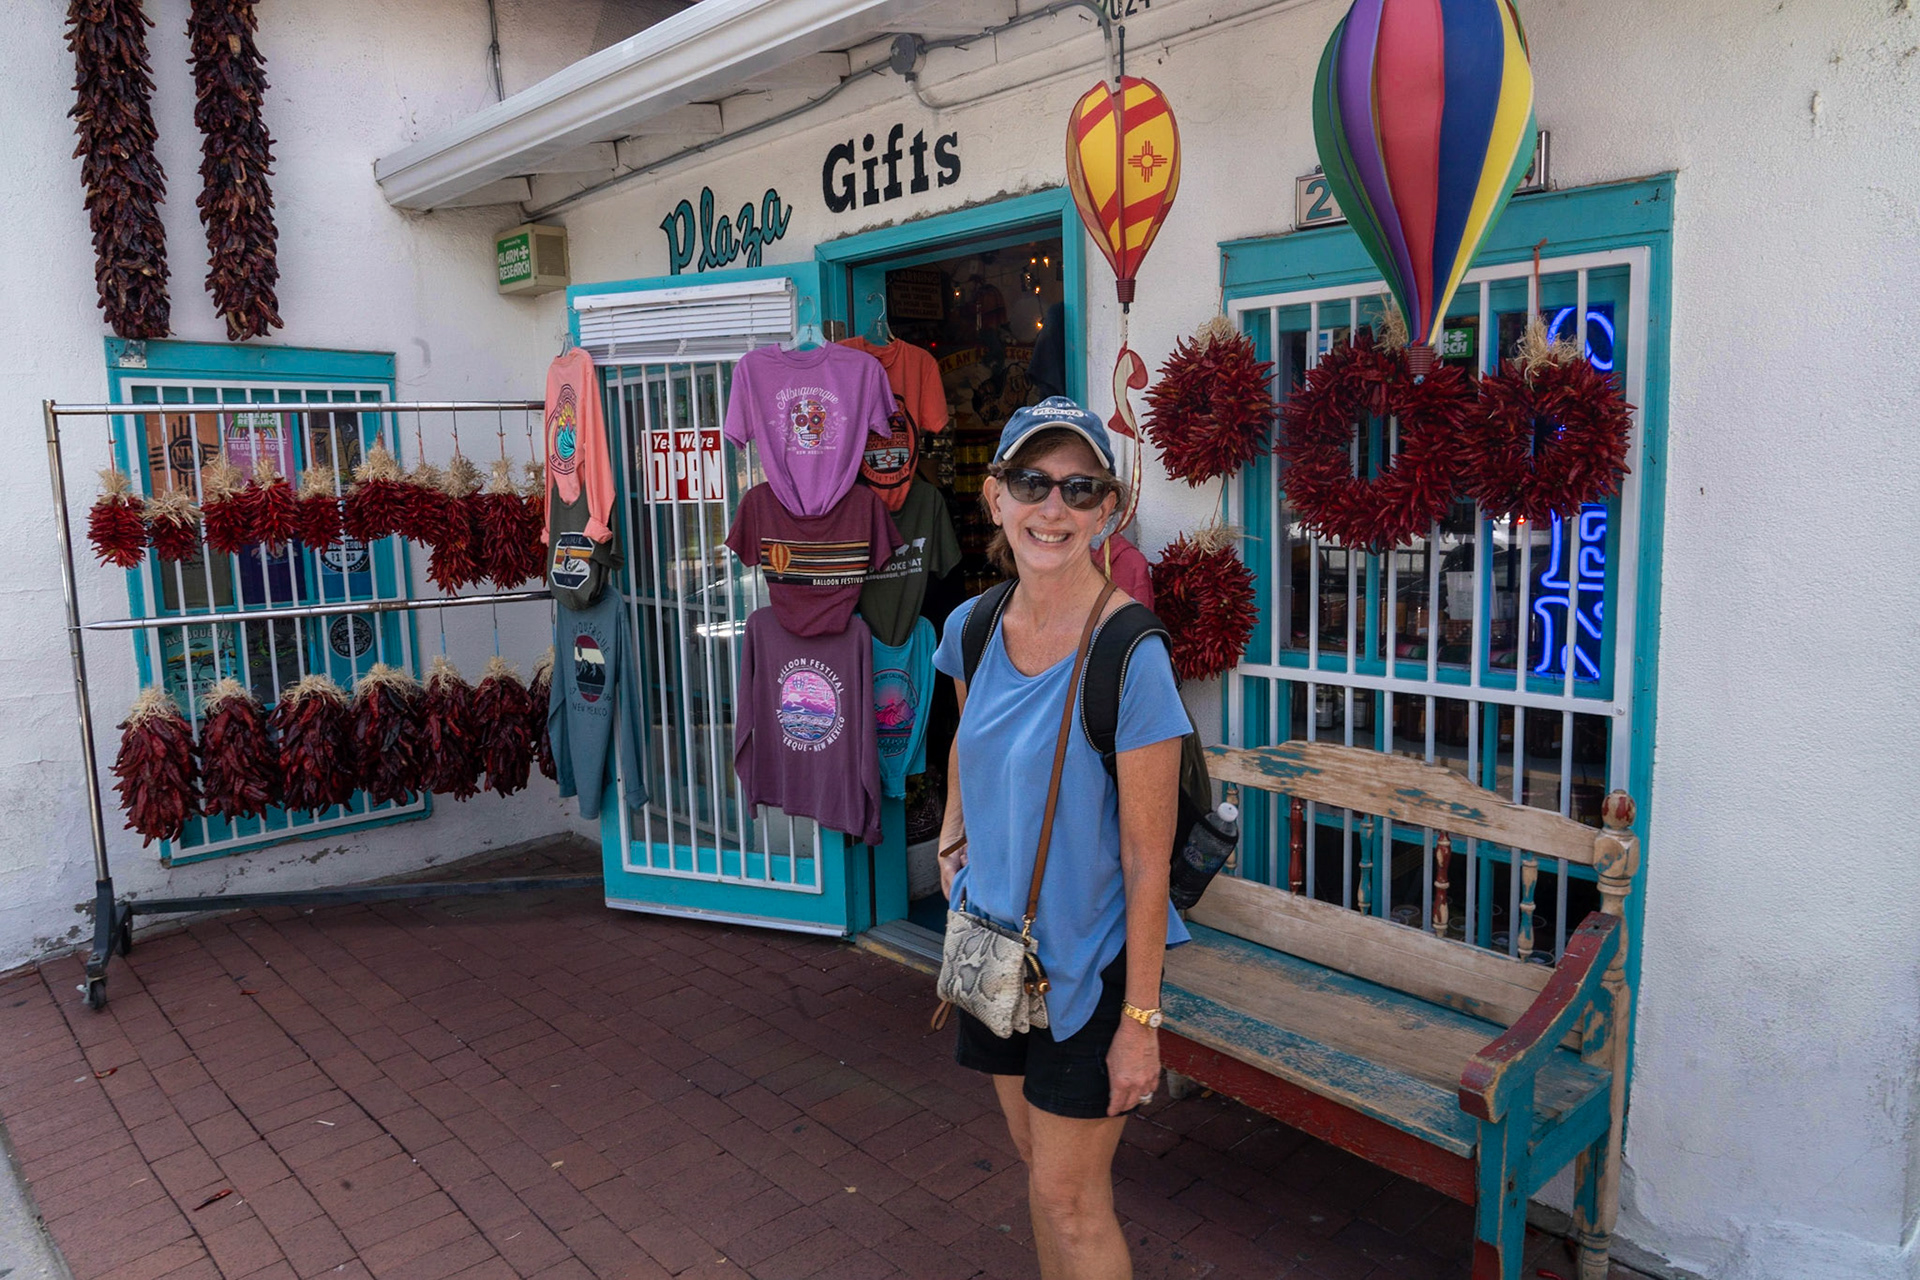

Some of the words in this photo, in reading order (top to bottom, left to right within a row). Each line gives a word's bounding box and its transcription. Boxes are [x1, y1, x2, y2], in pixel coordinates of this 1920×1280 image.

[822, 122, 962, 214] Gifts
[659, 185, 793, 276] Plaza
[498, 248, 520, 266] ALARM
[499, 260, 531, 281] RESEARCH
[775, 386, 839, 410] Albuquerque
[648, 450, 722, 500] OPEN
[812, 577, 840, 586] BALLOON
[840, 576, 864, 585] FESTIVA
[777, 657, 807, 685] BALLOON
[809, 659, 845, 695] FESTIVAL
[813, 742, 827, 752] NEW
[827, 716, 846, 745] MEXICO
